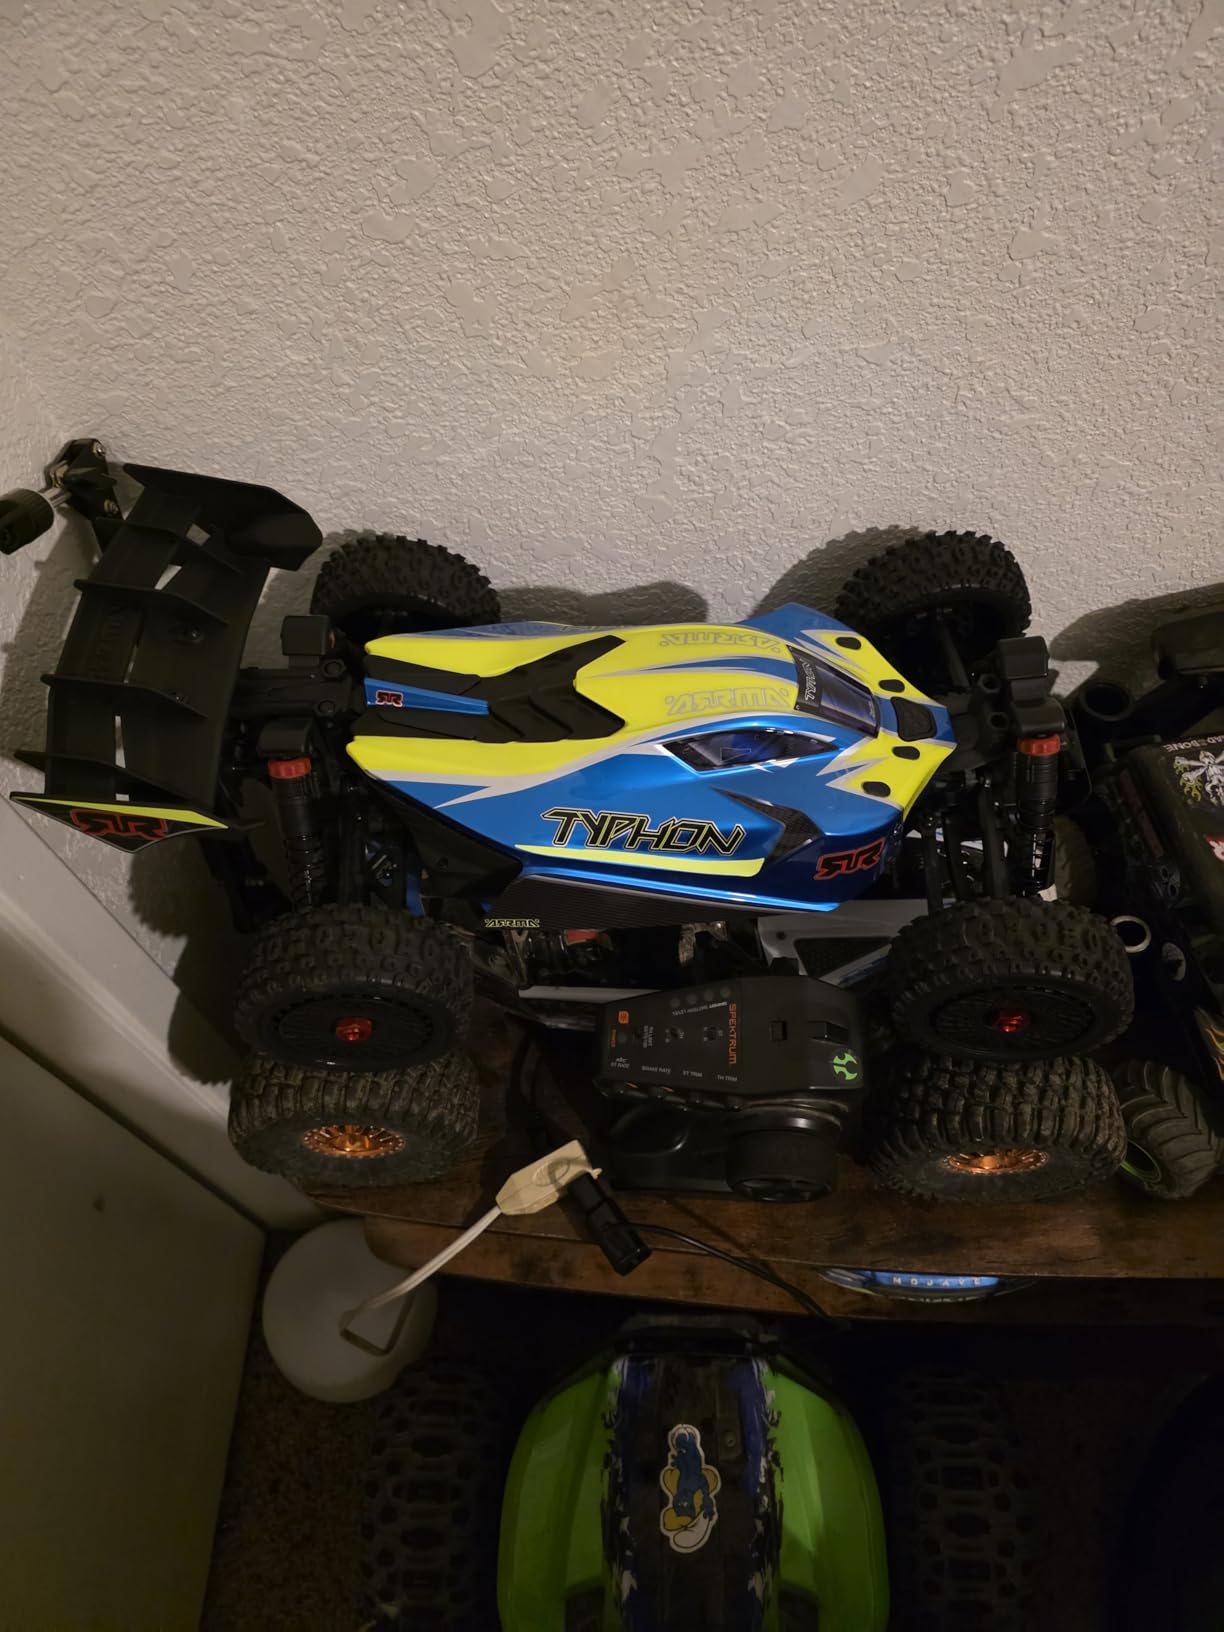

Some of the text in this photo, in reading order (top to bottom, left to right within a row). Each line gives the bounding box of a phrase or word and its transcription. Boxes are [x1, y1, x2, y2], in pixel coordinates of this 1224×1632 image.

[1163, 740, 1201, 752] BONE
[540, 806, 747, 856] TYPHON
[728, 1002, 737, 1065] SPEKTRUM
[892, 1275, 982, 1287] MOJAVE
